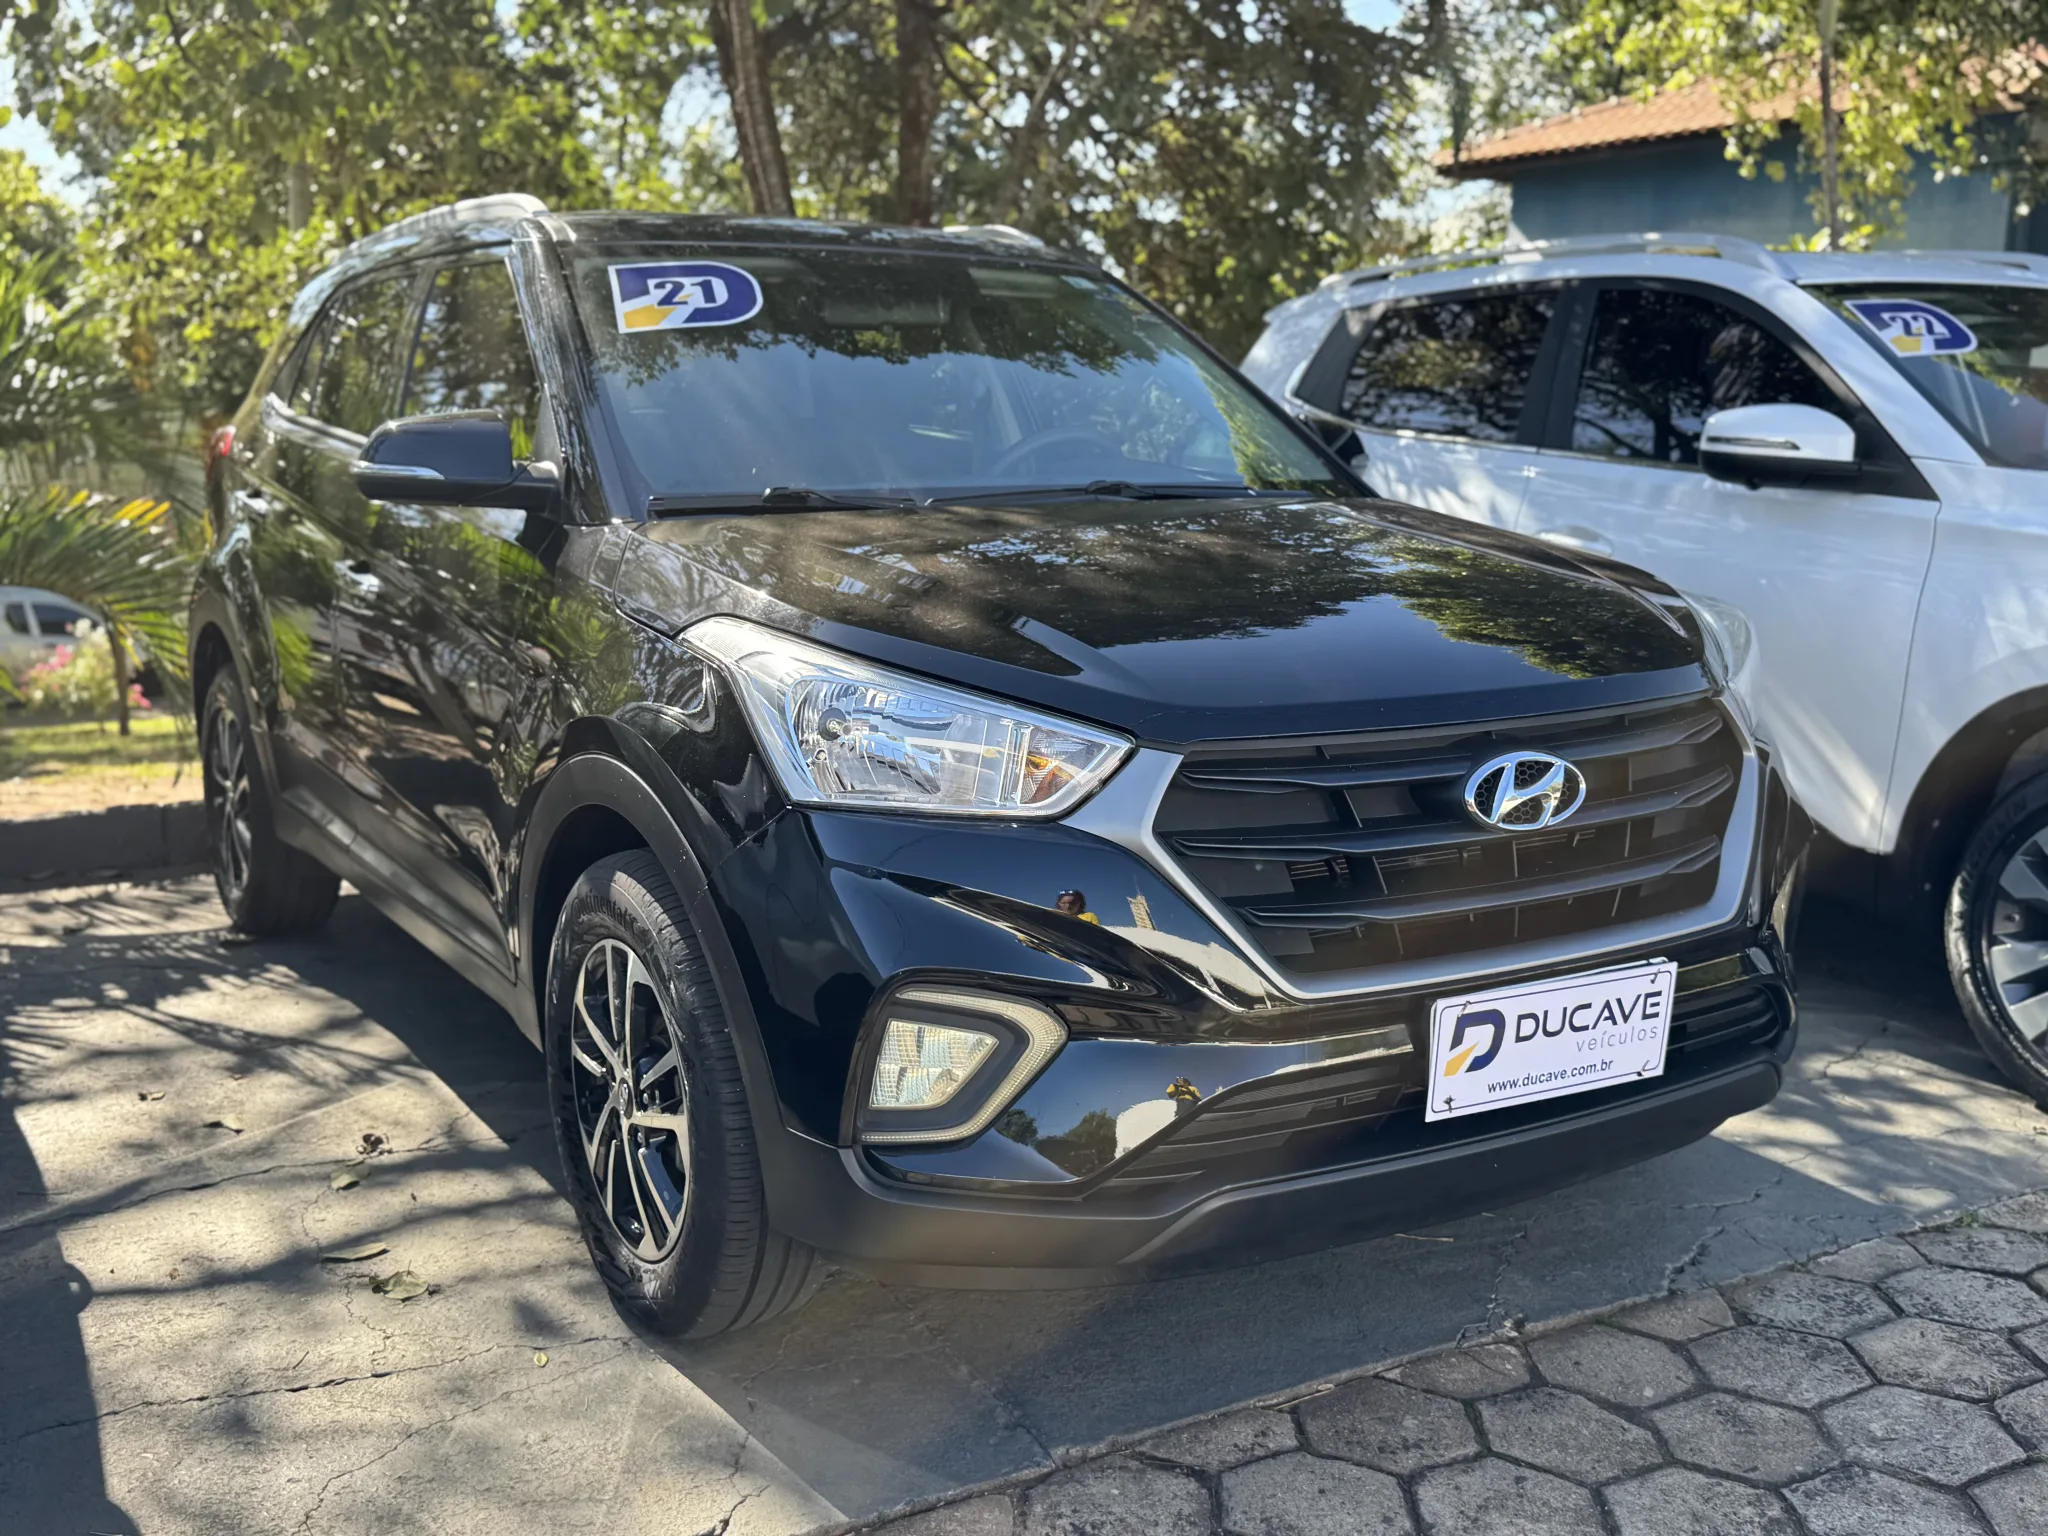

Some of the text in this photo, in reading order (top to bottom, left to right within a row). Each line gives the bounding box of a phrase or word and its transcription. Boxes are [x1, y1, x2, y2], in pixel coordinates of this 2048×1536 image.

[653, 278, 718, 307] 21
[1888, 314, 1948, 337] 22
[1514, 990, 1663, 1044] DUCAVE
[1576, 1025, 1658, 1053] veículos
[1487, 1059, 1614, 1094] www.ducave.com.br
